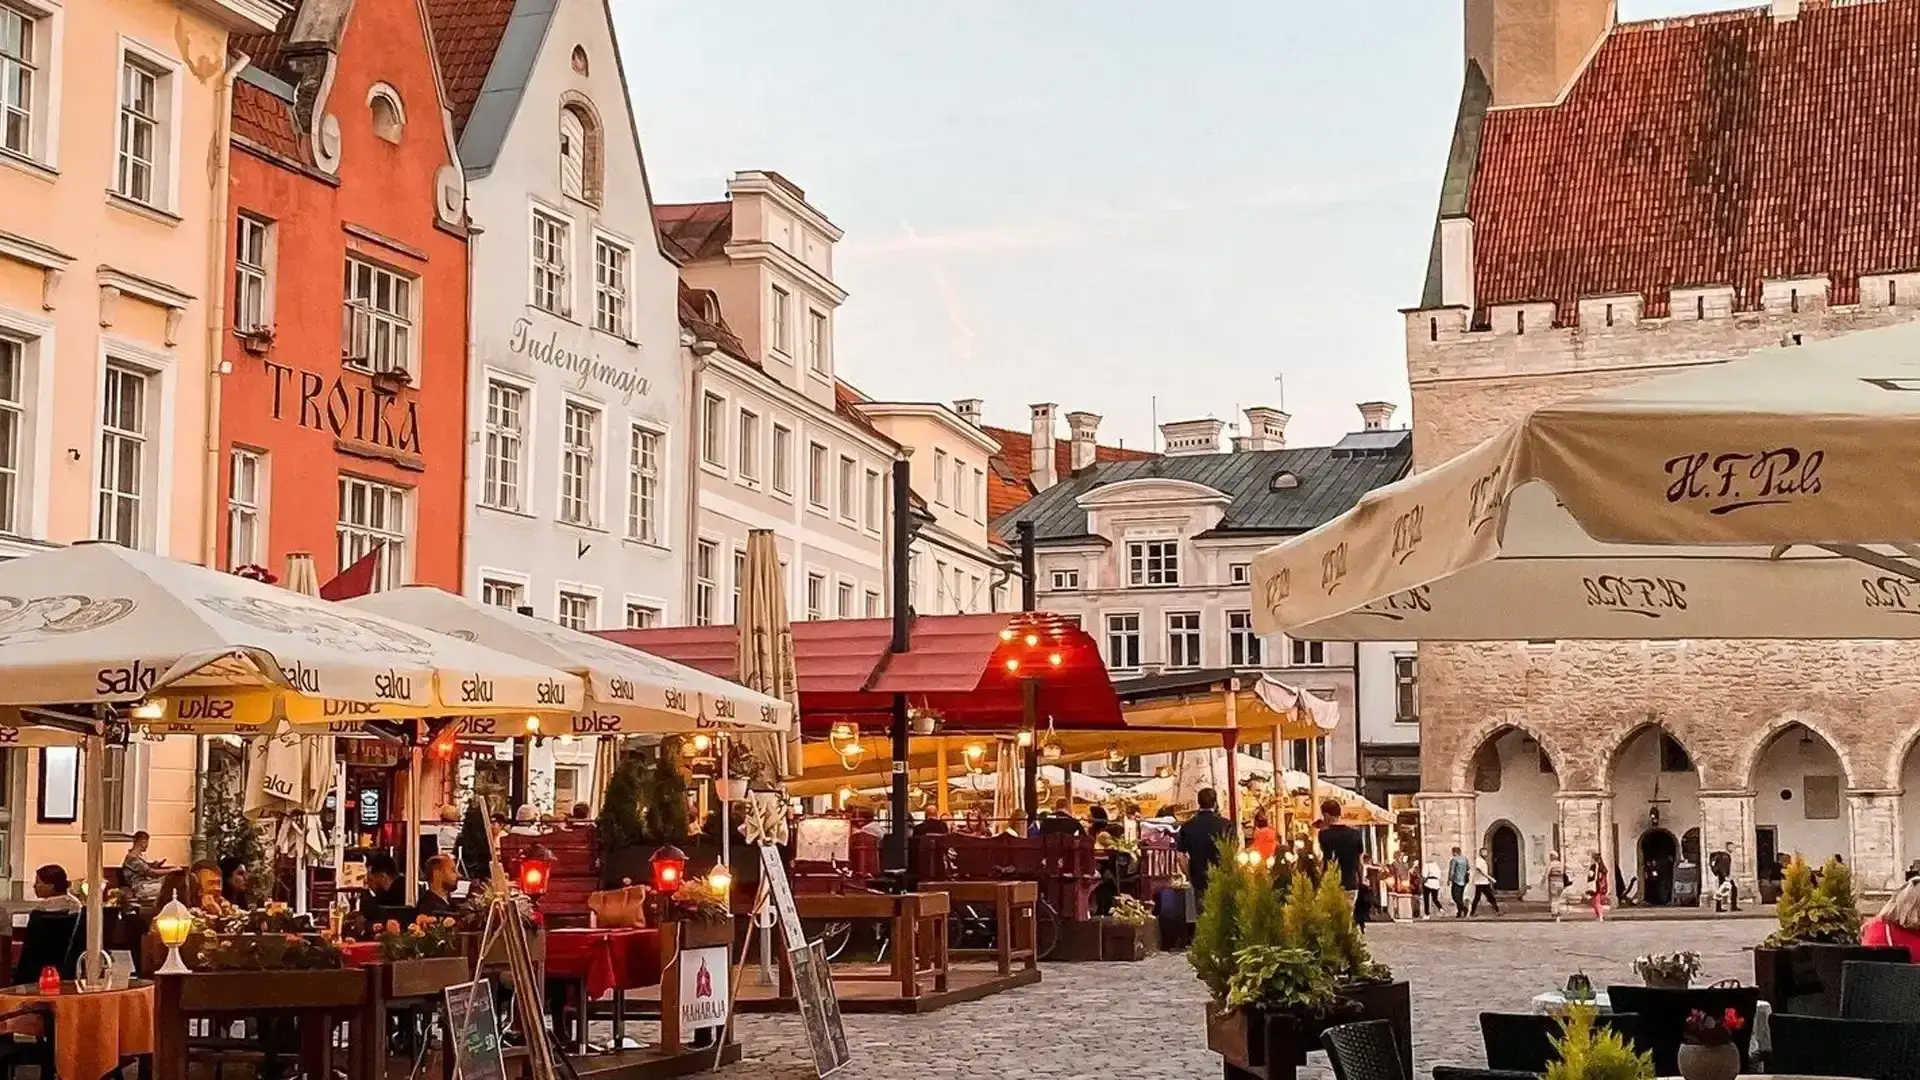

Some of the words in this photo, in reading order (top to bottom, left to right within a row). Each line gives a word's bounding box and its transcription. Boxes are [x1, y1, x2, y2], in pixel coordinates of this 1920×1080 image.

[509, 317, 653, 406] Tudengimaja
[264, 360, 423, 455] TROIKA
[375, 668, 411, 700] saku
[462, 673, 494, 702] saku
[537, 677, 565, 704] saku
[610, 675, 634, 700] saku
[665, 687, 686, 711] saku
[715, 694, 735, 718] saku
[760, 703, 778, 724] saku
[263, 774, 293, 795] aku
[682, 1000, 726, 1022] MAHARAJA
